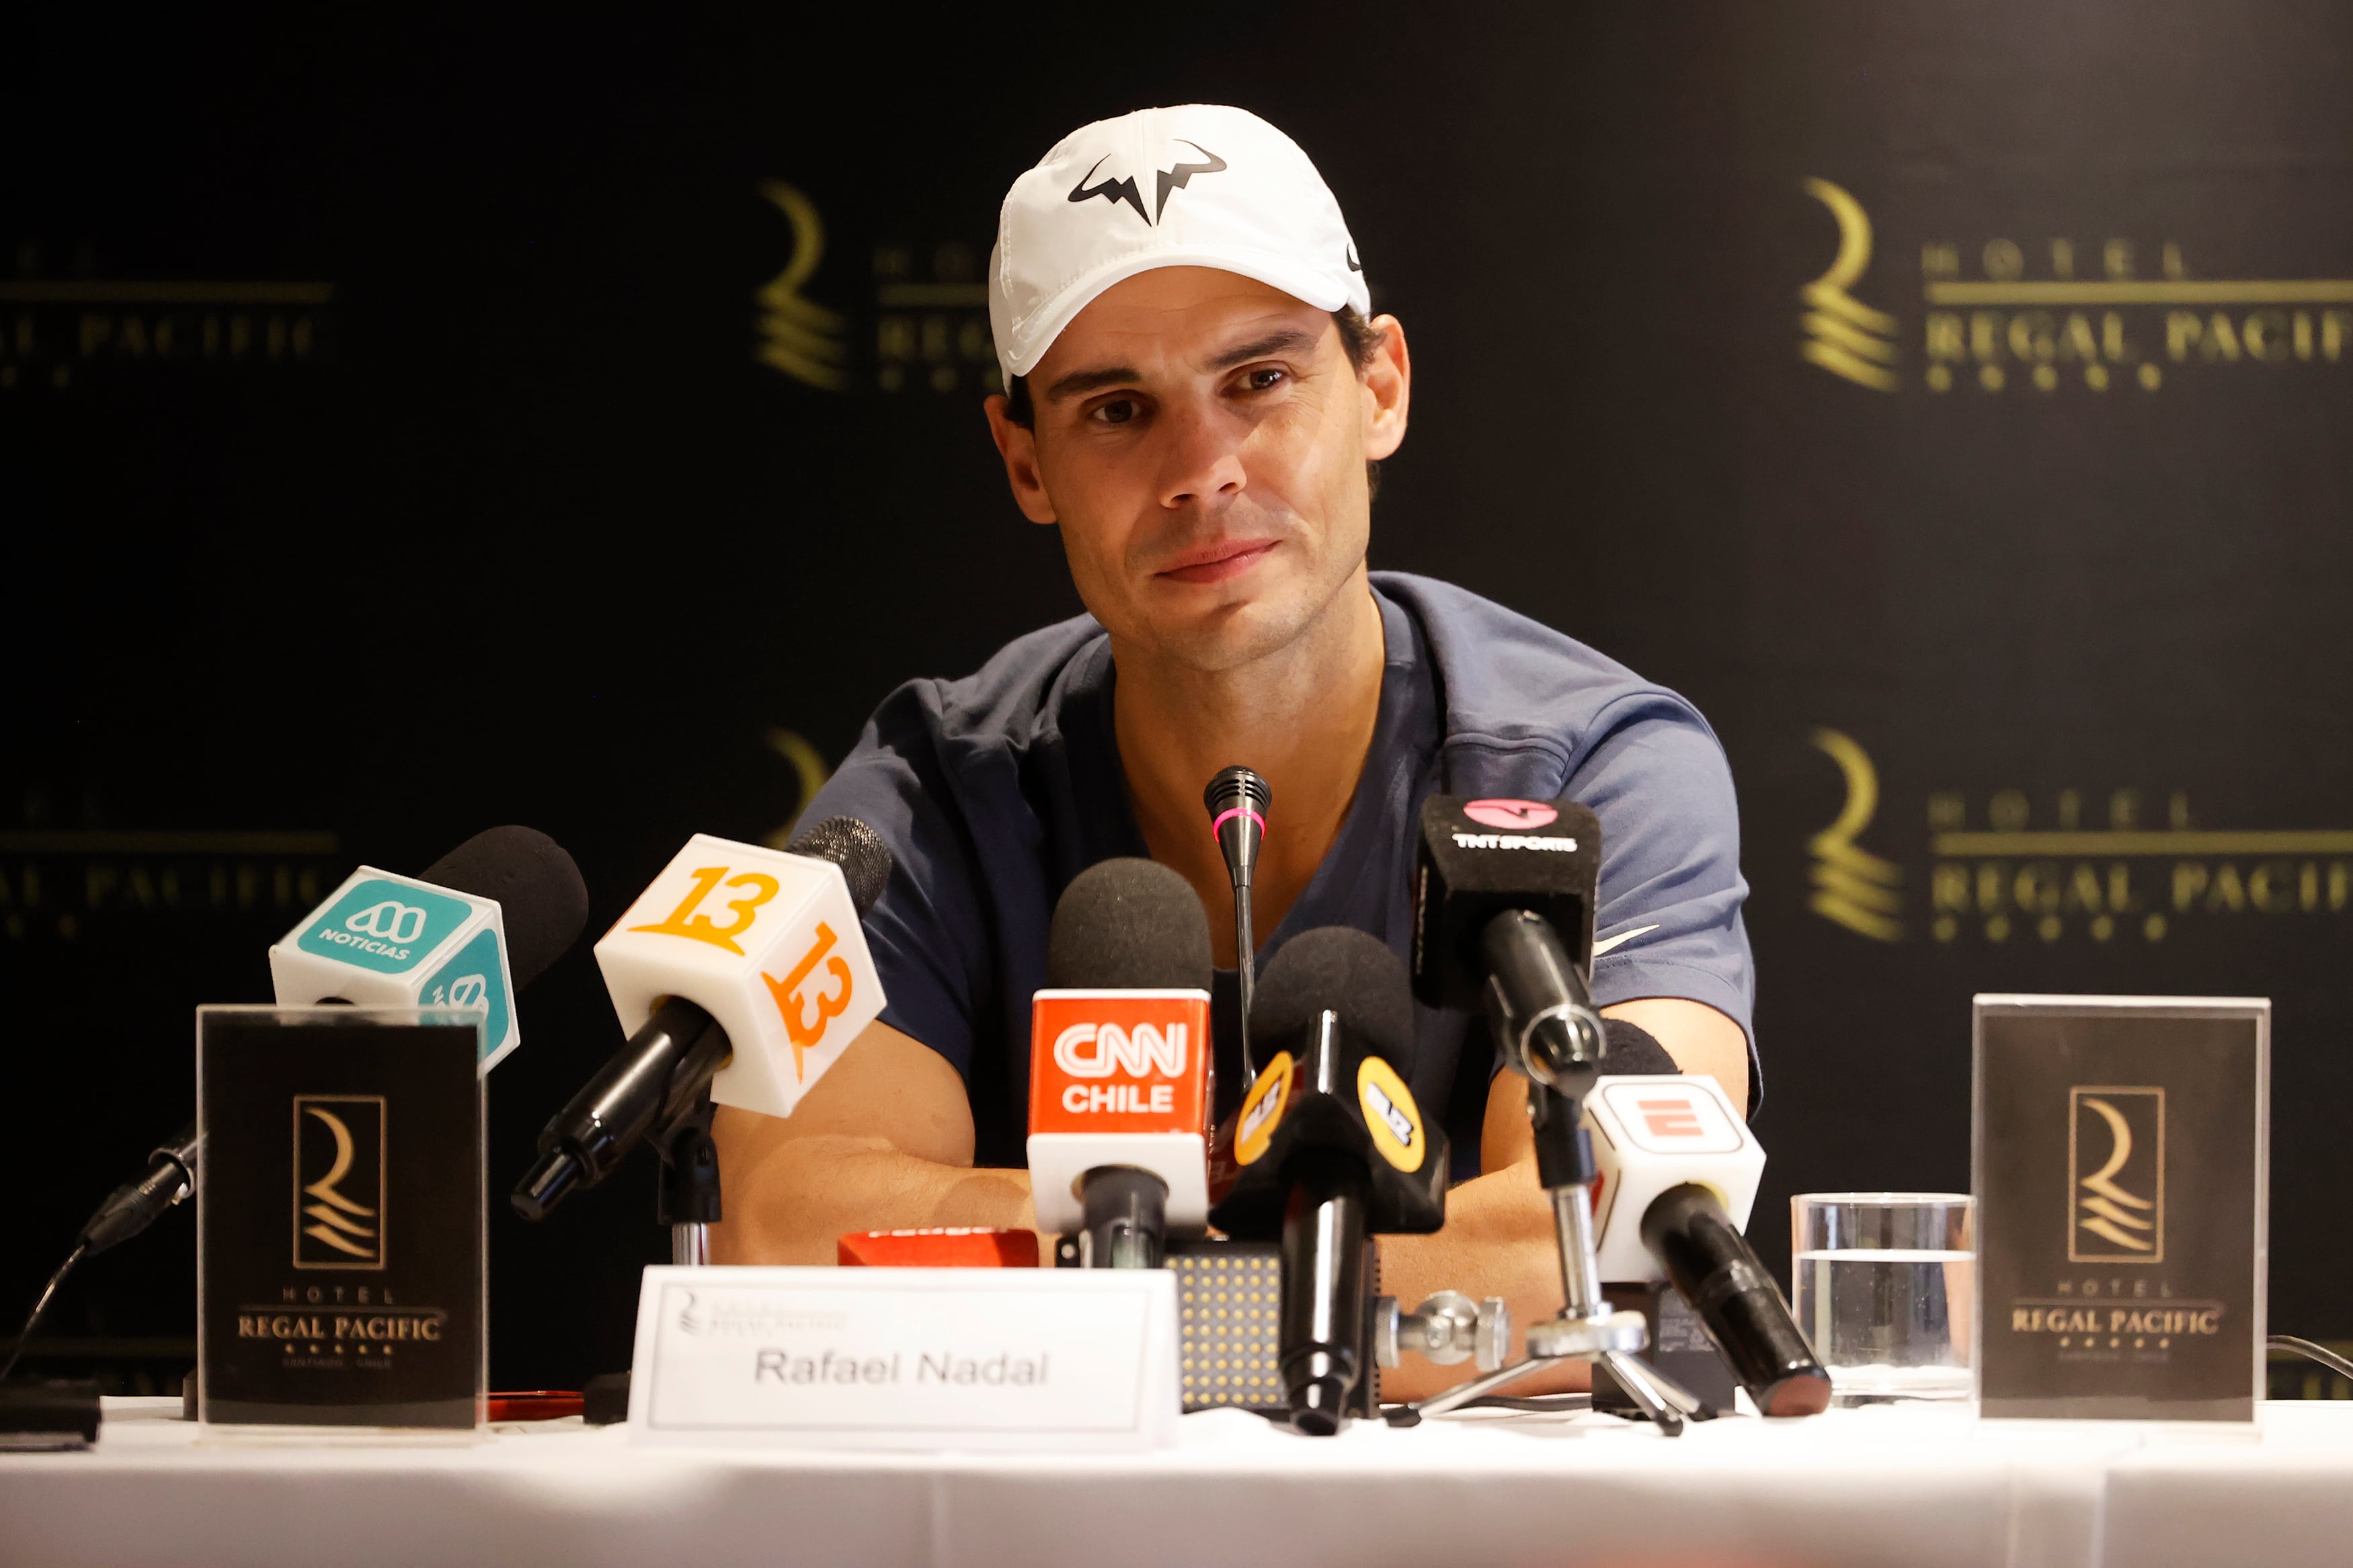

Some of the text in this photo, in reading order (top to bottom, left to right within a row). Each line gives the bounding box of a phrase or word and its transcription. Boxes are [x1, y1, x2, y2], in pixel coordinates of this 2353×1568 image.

[1925, 311, 2138, 362] REGAL
[1931, 861, 2139, 913] REGAL
[626, 866, 780, 956] 13
[318, 928, 410, 961] NOTICIAS
[760, 920, 852, 1085] 13
[1053, 1022, 1188, 1078] CNN
[1062, 1085, 1174, 1114] CHILE
[282, 1284, 394, 1305] HOTEL
[239, 1315, 442, 1342] REGAL PACIFIC
[2011, 1308, 2219, 1336] REGAL PACIFIC
[754, 1348, 1050, 1387] Rafael Nadal
